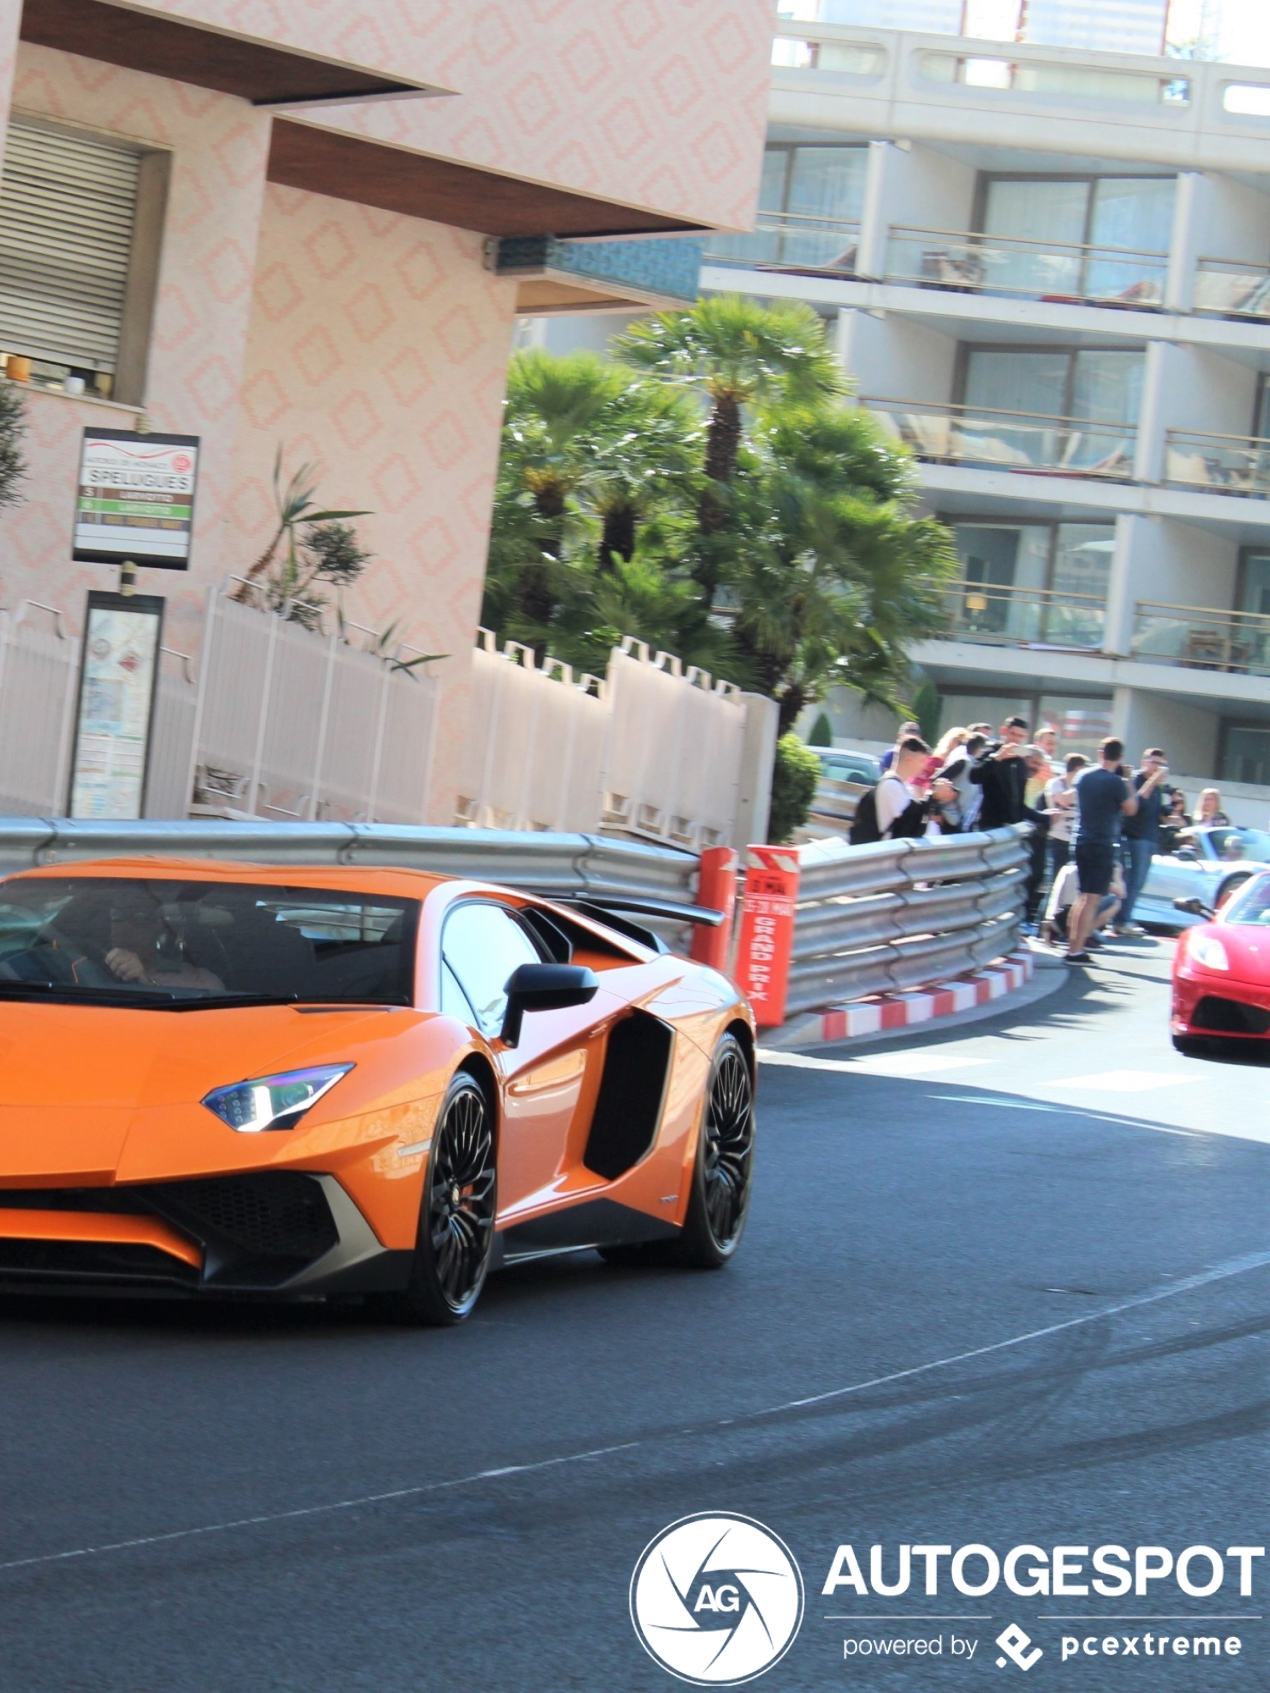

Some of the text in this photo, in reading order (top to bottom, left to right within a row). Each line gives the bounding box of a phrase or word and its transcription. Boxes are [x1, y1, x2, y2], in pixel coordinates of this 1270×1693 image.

[89, 469, 189, 490] SPELUGUES
[750, 916, 777, 961] GRAND
[747, 963, 771, 1002] PRIX
